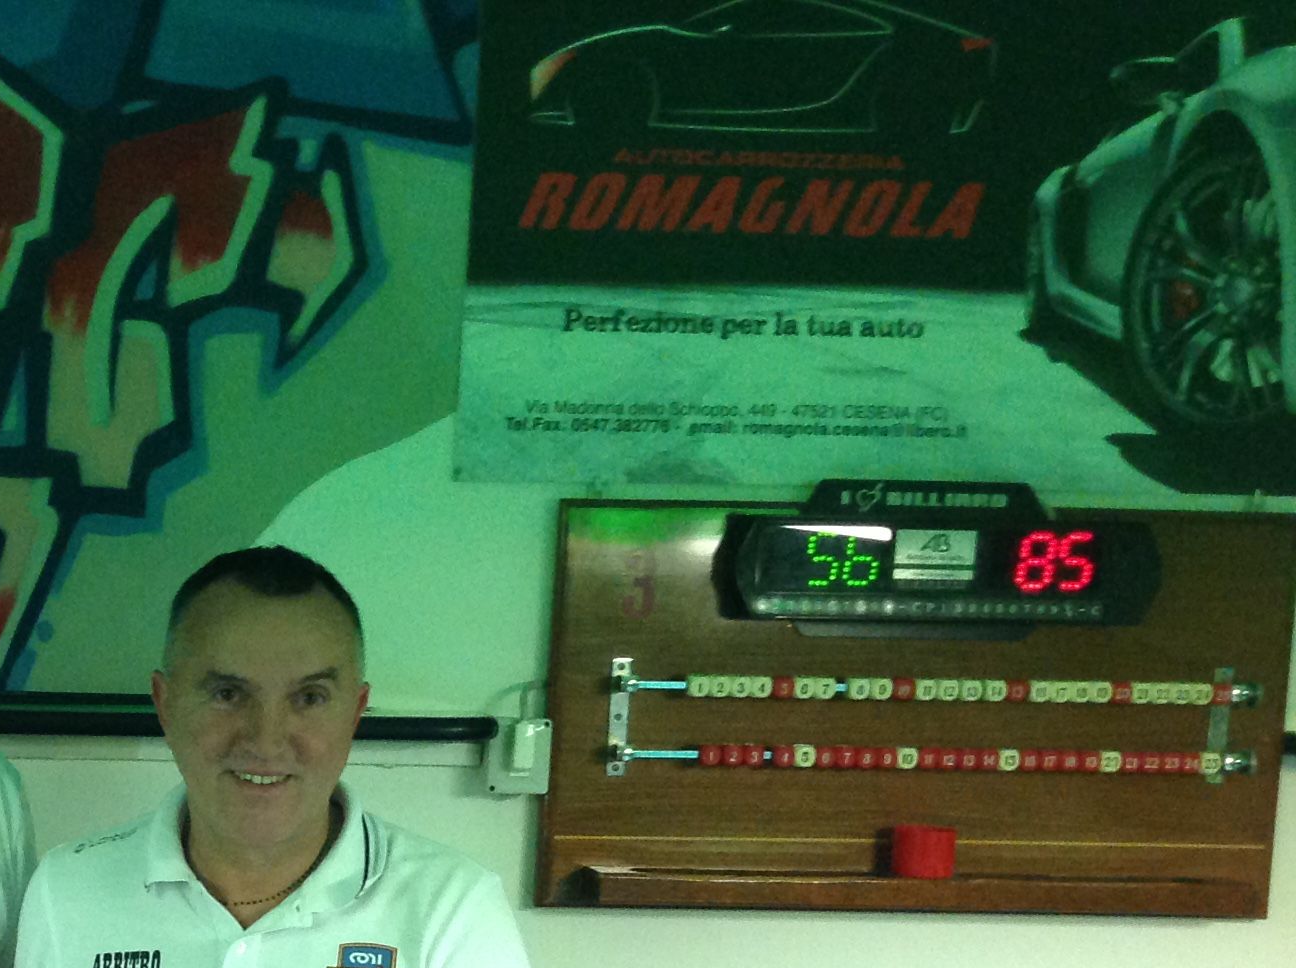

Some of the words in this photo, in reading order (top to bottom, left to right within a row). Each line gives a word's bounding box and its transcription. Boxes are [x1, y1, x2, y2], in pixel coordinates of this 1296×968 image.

[518, 172, 986, 239] ROMAGNOLA
[562, 308, 714, 335] Perfezione
[720, 314, 767, 340] per
[774, 312, 799, 336] la
[806, 314, 853, 337] tua
[860, 316, 926, 339] auto
[842, 404, 910, 419] CESENA
[807, 531, 880, 588] 56
[1014, 530, 1096, 593] 85
